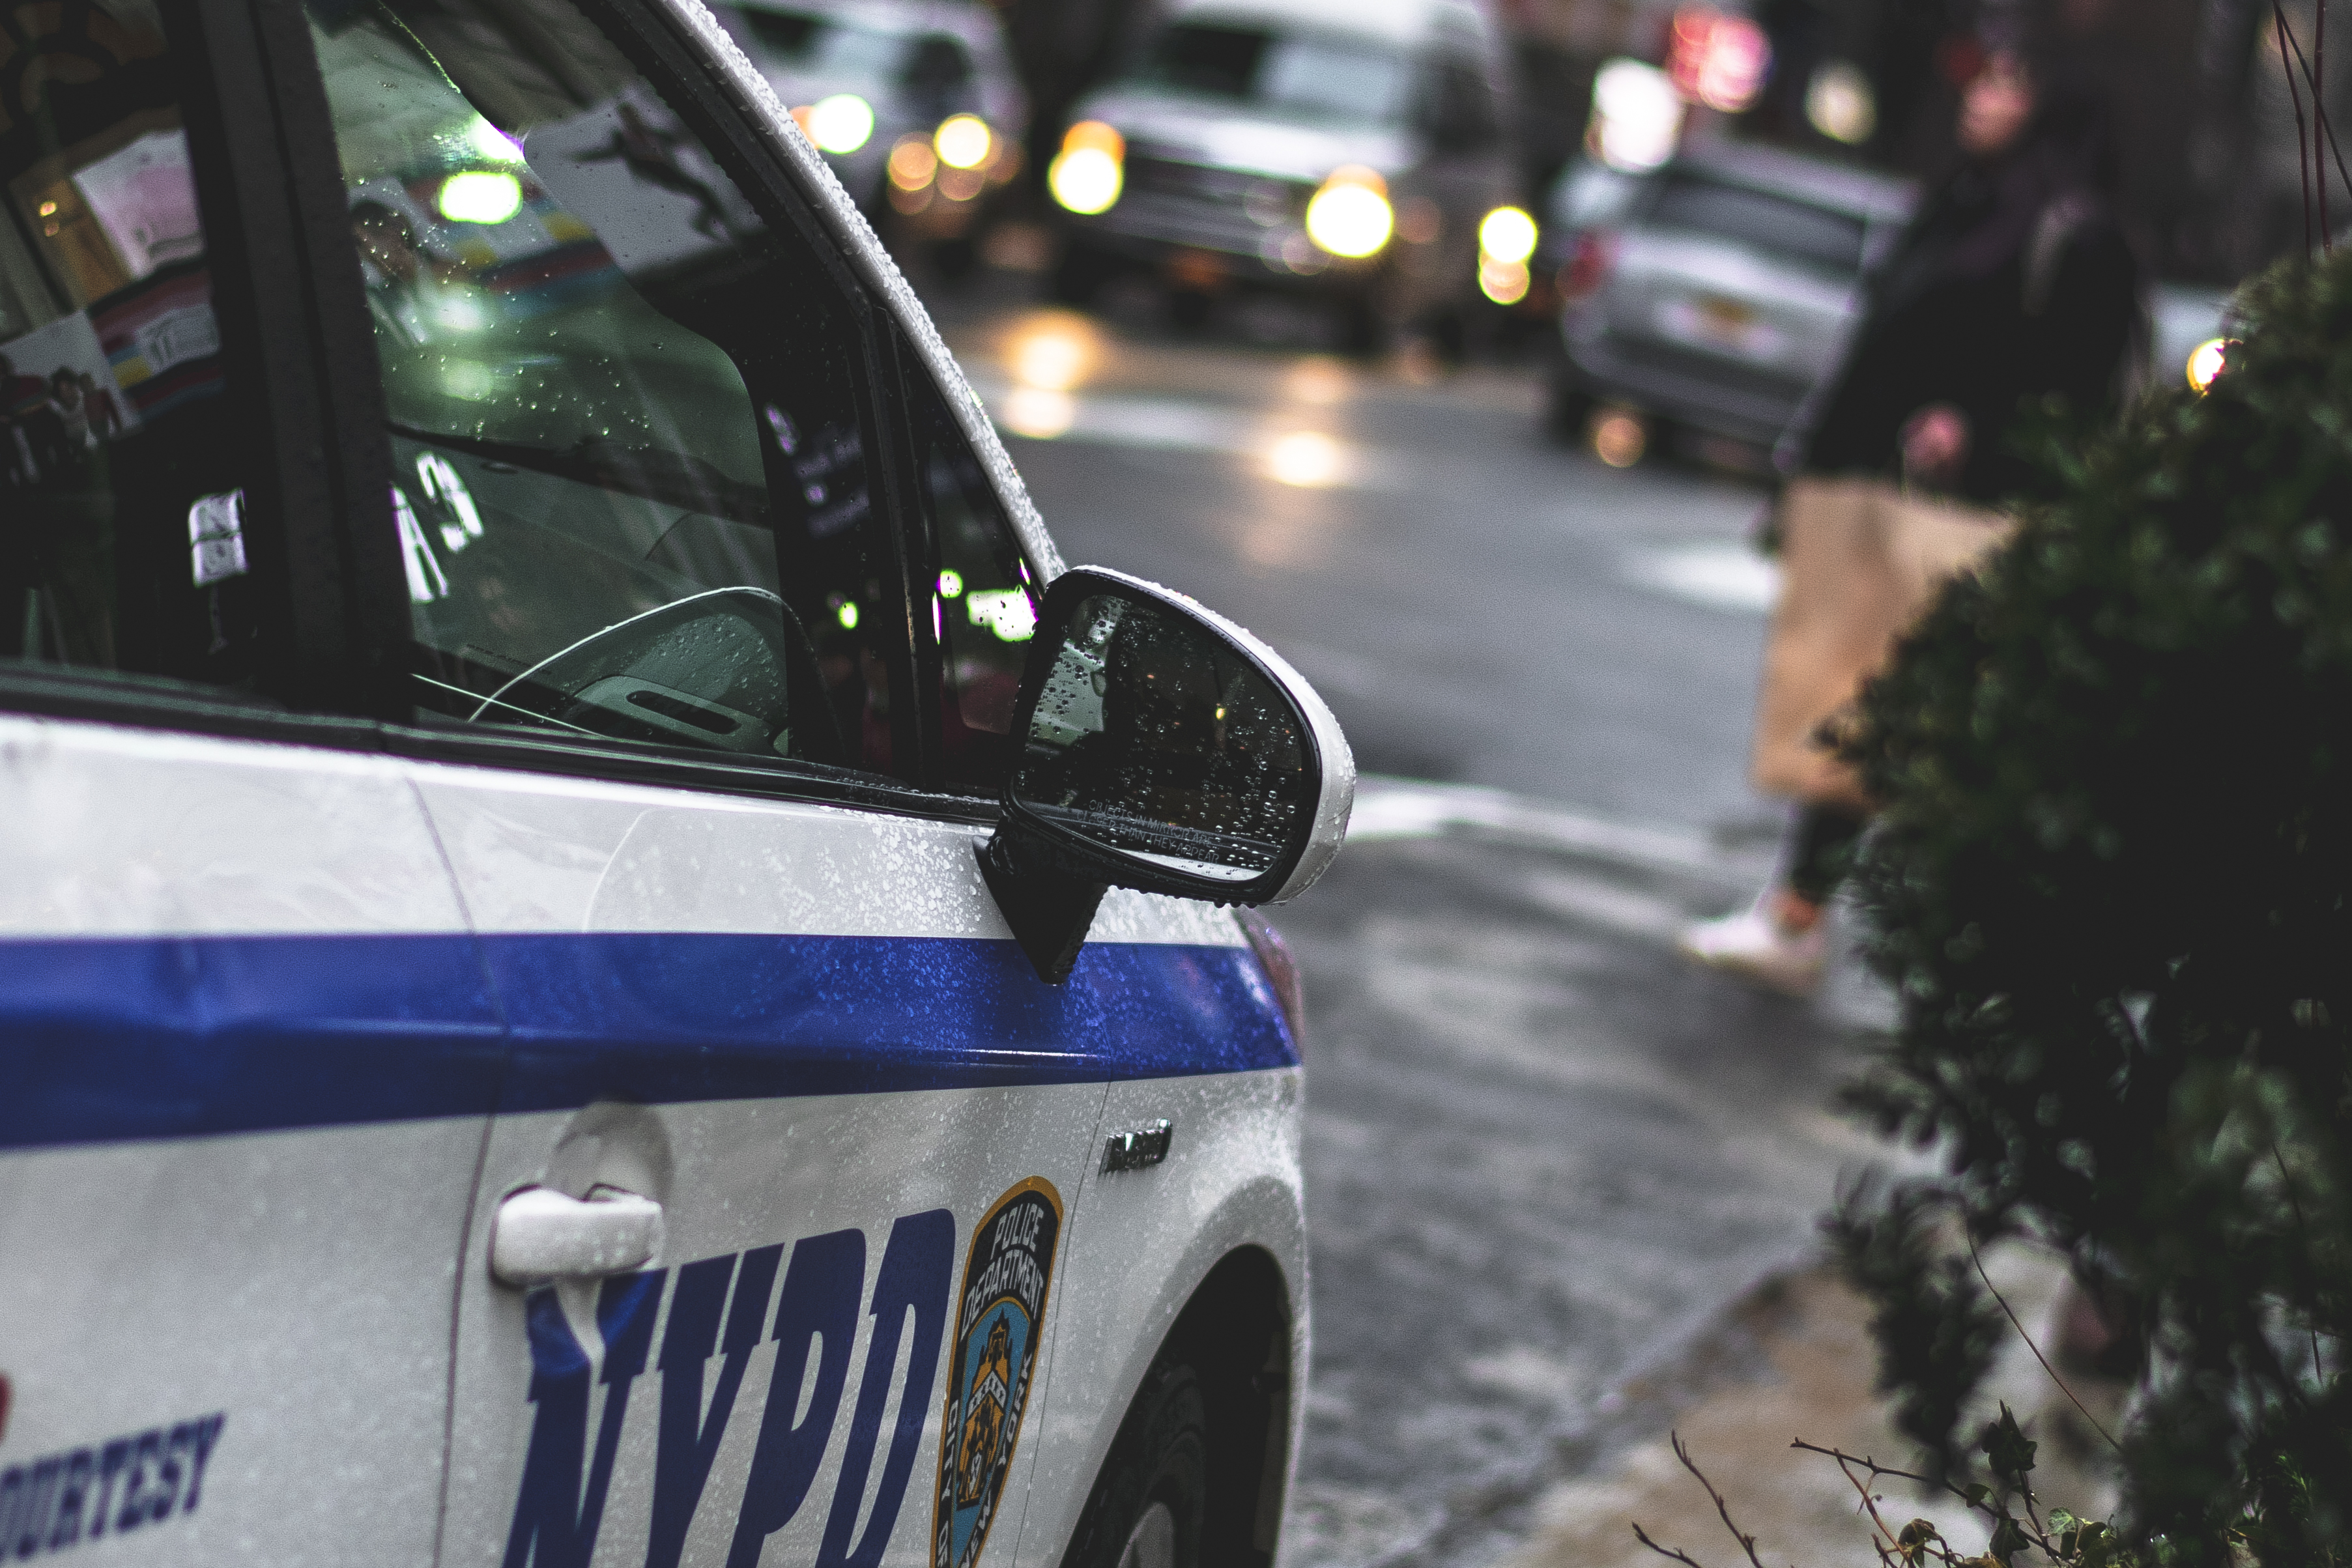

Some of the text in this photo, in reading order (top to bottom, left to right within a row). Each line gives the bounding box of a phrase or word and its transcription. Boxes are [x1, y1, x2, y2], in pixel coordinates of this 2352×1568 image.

[1076, 810, 1220, 864] CLOSER THAN THEY APPEAR
[1089, 799, 1215, 848] OBJECTS IN MIRROR ARE
[990, 1203, 1044, 1261] POLICE
[960, 1249, 1044, 1342] DEPARTMENT
[500, 1208, 956, 1568] NYPD
[997, 1352, 1032, 1466] YORK
[941, 1399, 958, 1502] CITY
